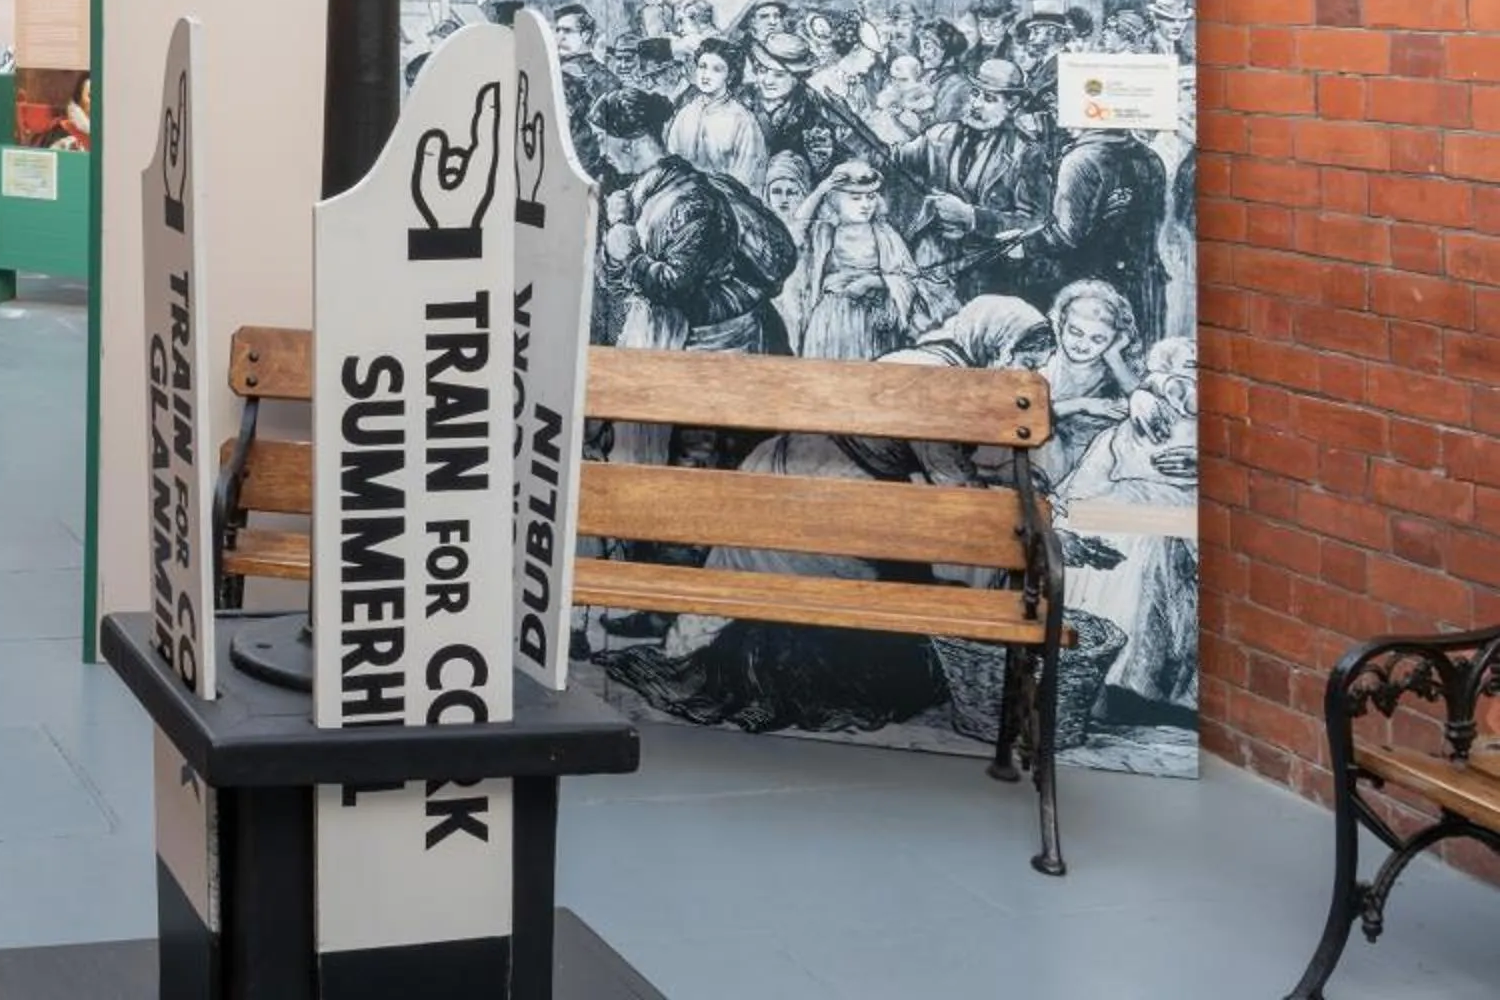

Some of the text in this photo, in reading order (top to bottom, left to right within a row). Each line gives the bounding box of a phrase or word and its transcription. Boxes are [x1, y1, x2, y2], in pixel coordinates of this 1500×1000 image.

[150, 333, 175, 670] GLANMIR
[425, 290, 490, 492] TRAIN
[169, 271, 200, 804] TRAIN FOR COK
[425, 519, 470, 619] FOR
[520, 402, 564, 669] DUBLIN
